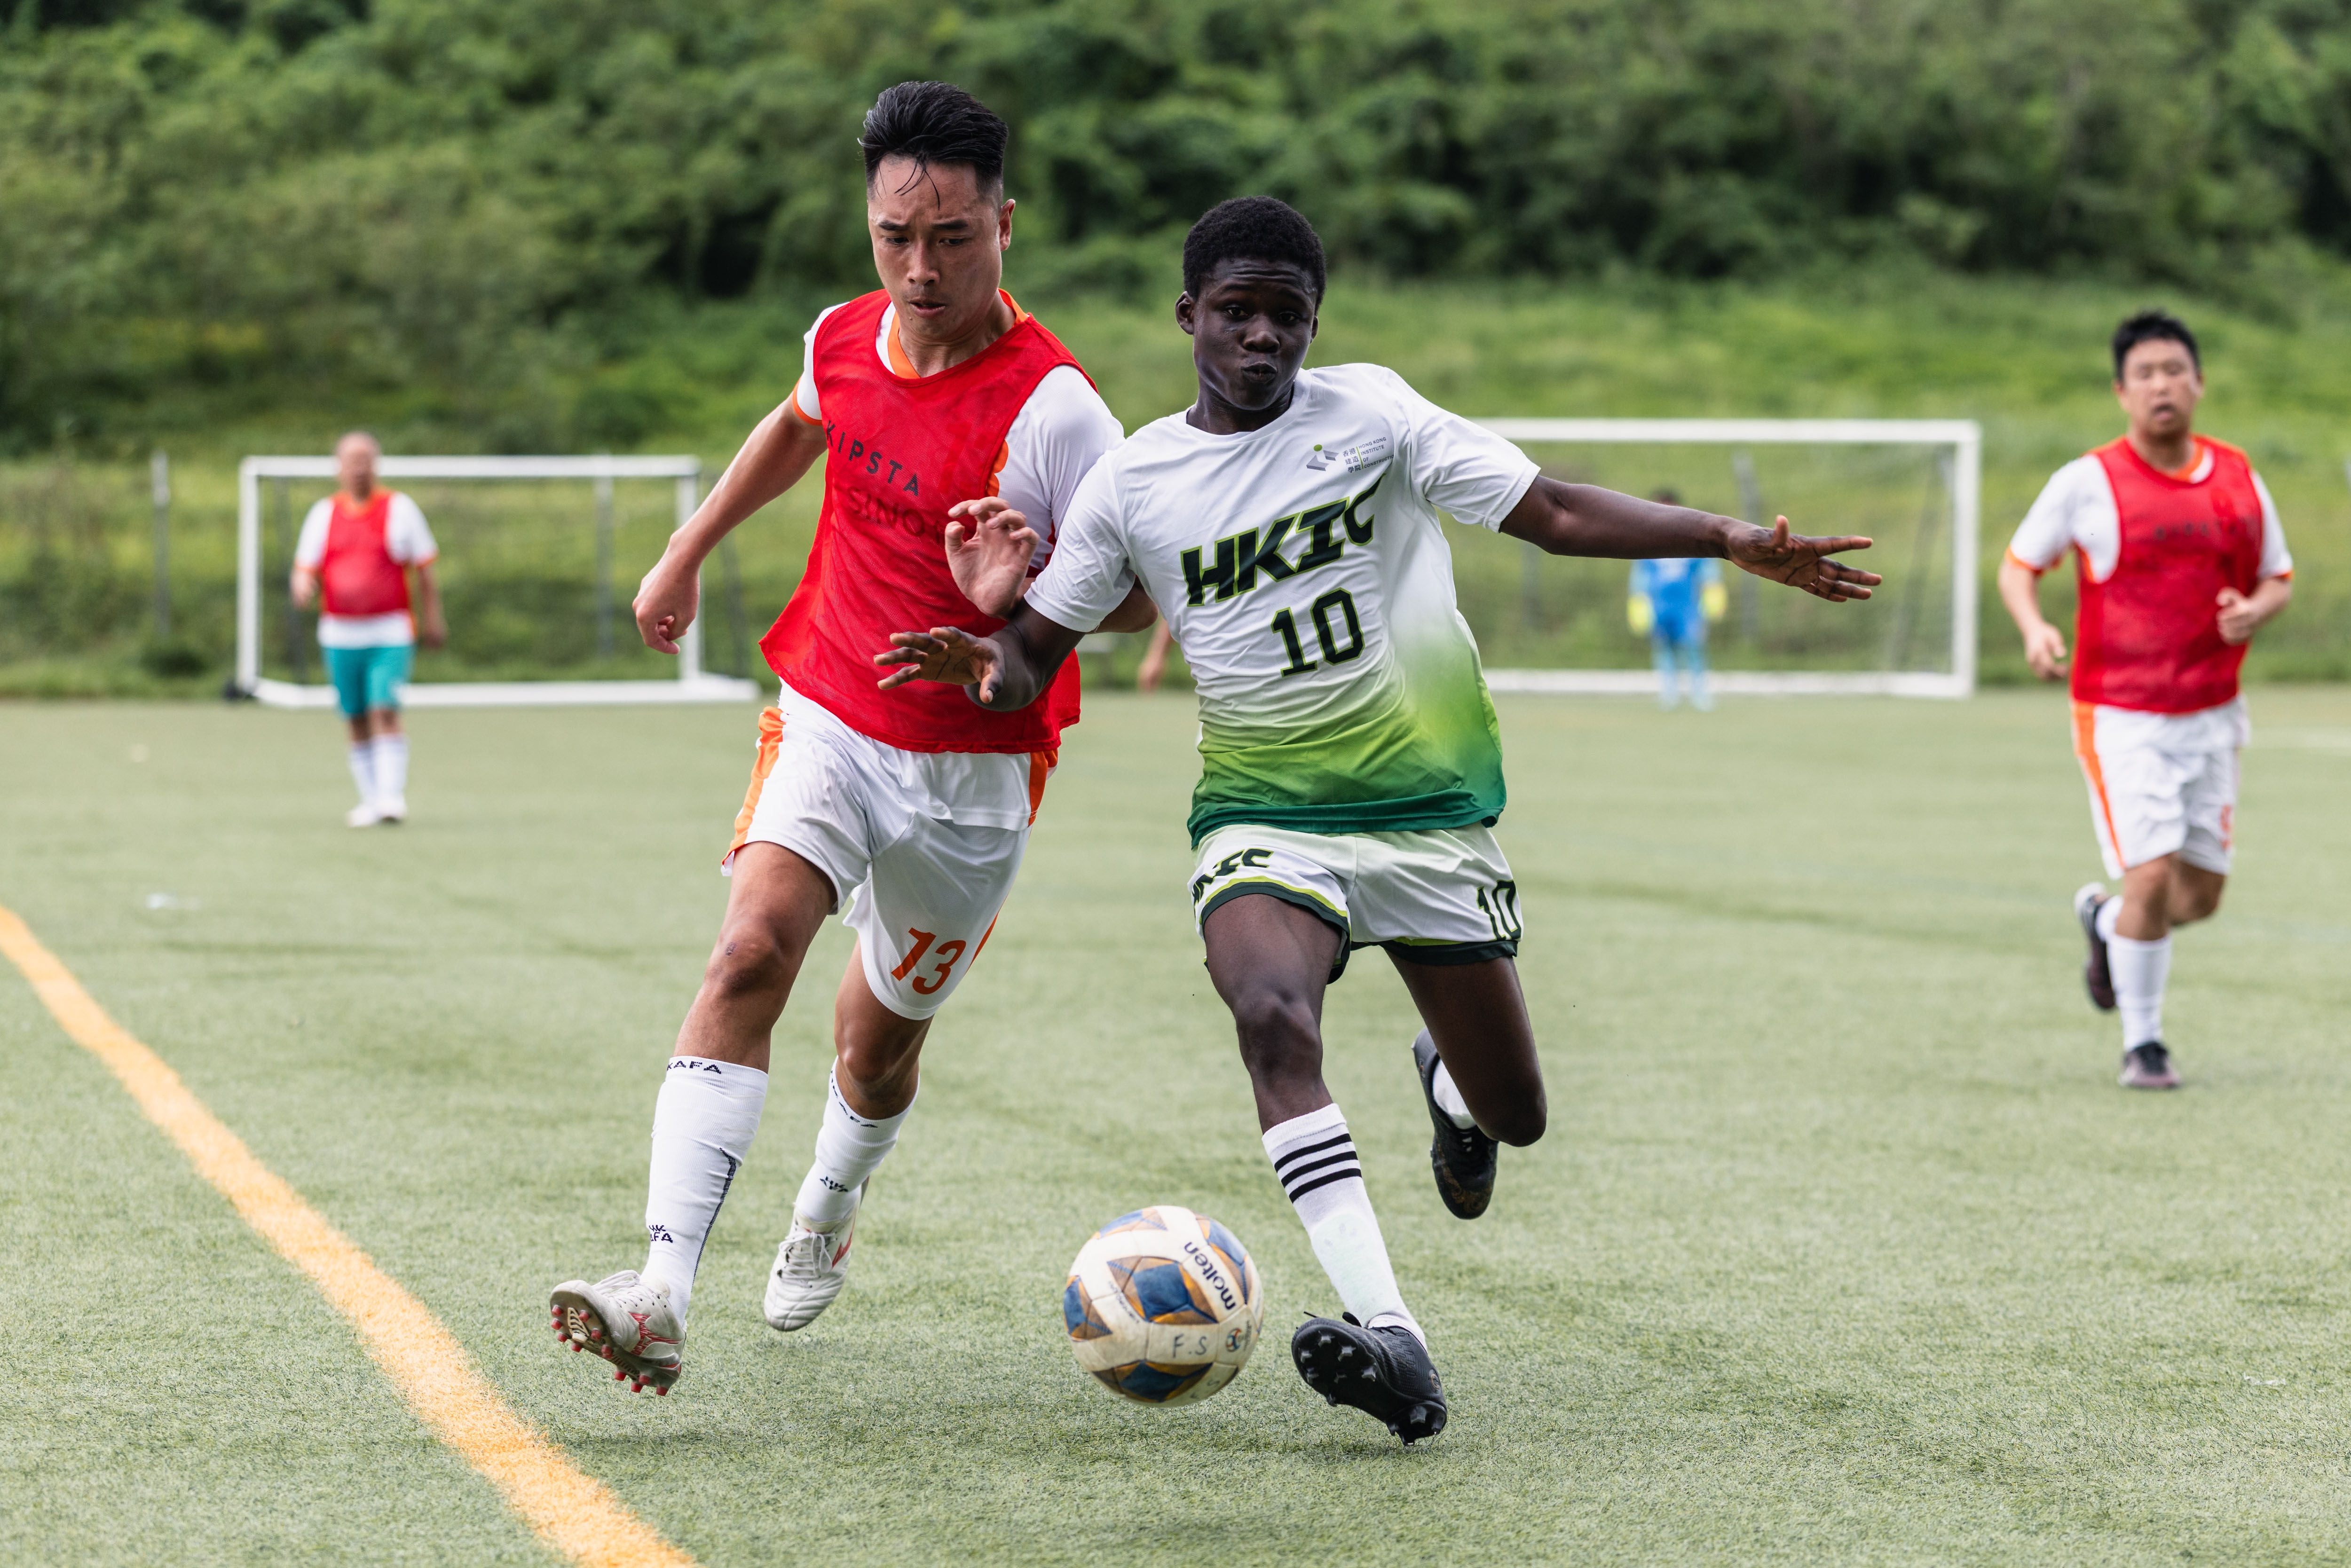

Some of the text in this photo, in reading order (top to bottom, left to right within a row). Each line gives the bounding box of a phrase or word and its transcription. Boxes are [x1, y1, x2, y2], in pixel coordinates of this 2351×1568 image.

[826, 420, 919, 496] KIPSTA
[1343, 448, 1356, 457] 香港
[1345, 456, 1359, 465] 建造
[1361, 444, 1385, 456] INSTITUTE
[1364, 455, 1394, 468] CONSTRUCTIO
[848, 486, 945, 545] SINO
[1180, 473, 1387, 607] HKIC
[1270, 588, 1365, 677] 10
[1476, 879, 1522, 940] 10
[891, 927, 967, 995] 13
[1184, 1242, 1236, 1310] molten
